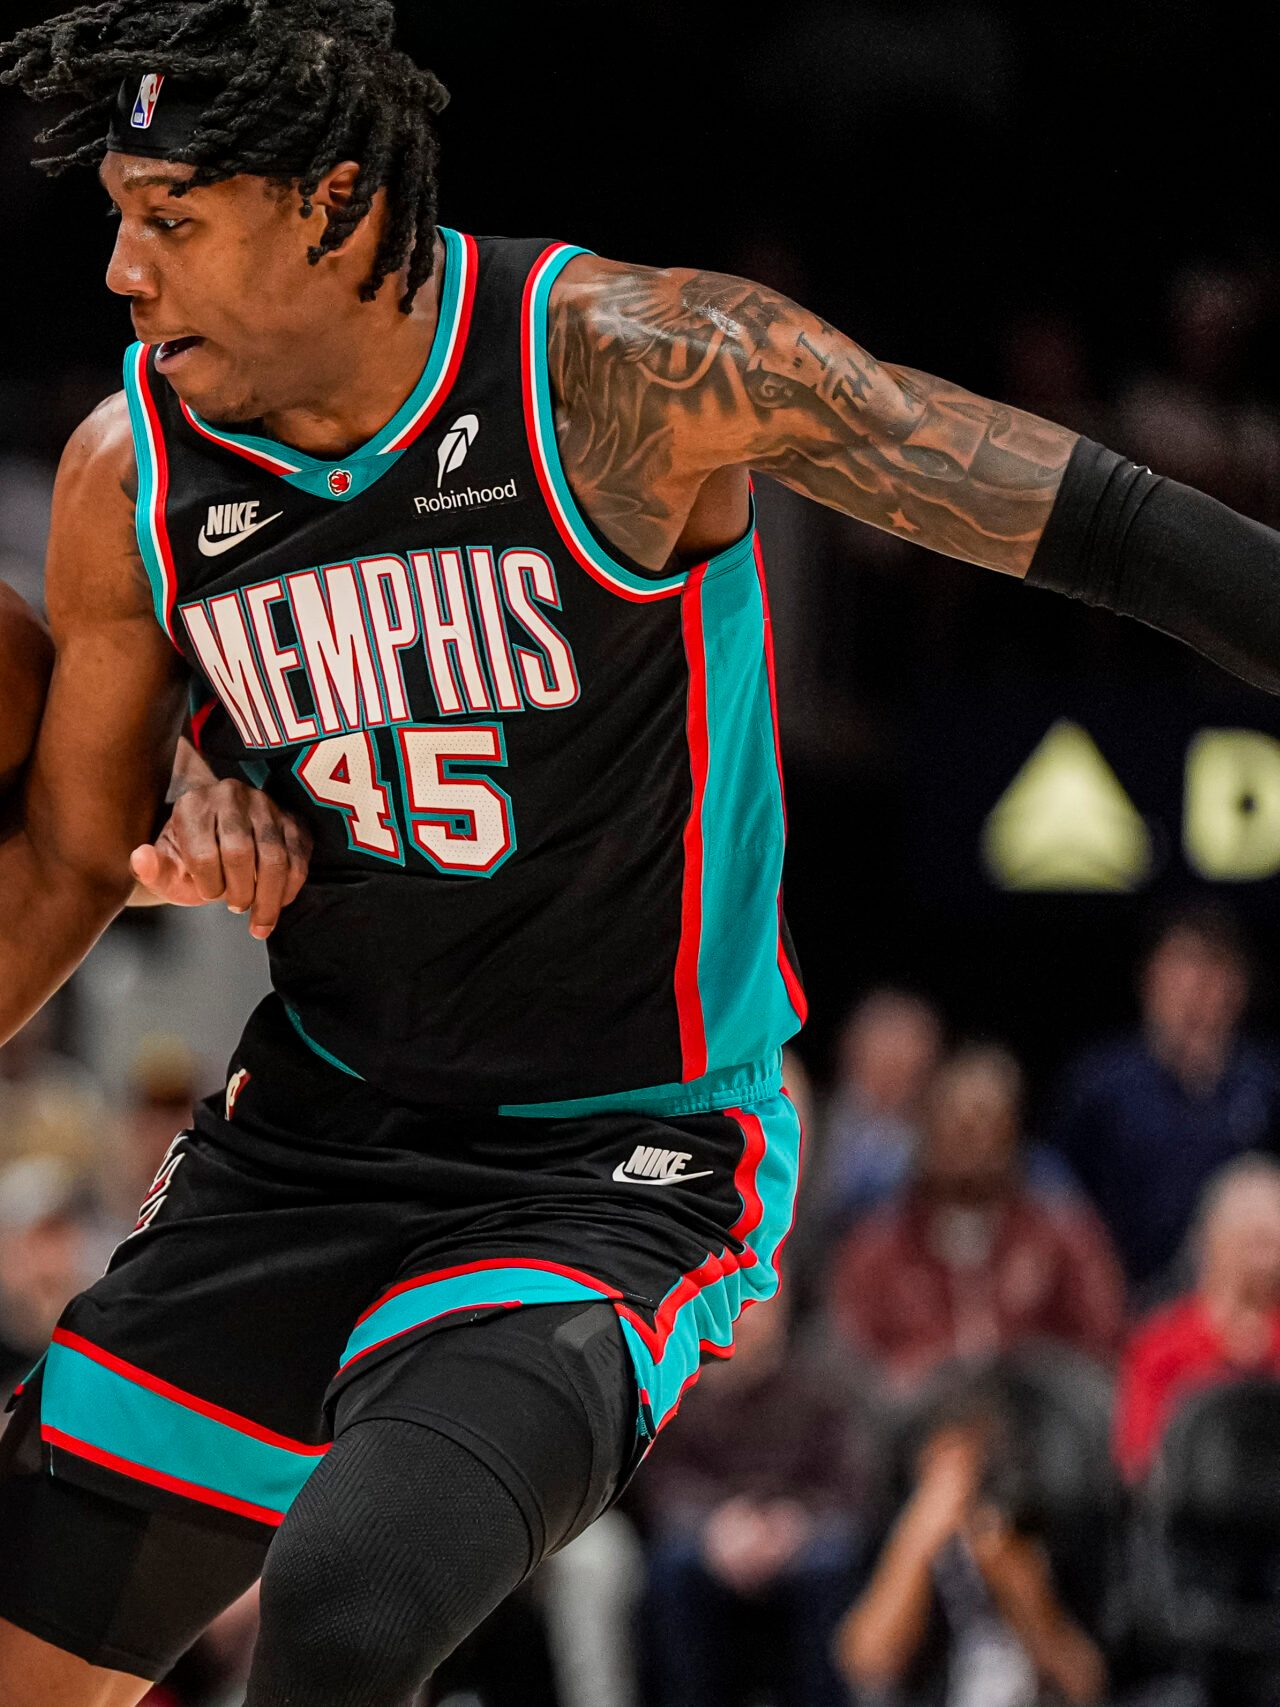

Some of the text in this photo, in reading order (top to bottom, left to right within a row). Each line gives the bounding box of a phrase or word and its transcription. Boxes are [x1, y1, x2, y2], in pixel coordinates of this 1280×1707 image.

[414, 479, 518, 514] Robinhood
[206, 500, 260, 536] NIKE
[177, 545, 582, 749] MEMPHIS
[291, 721, 518, 879] 45
[623, 1145, 693, 1179] NIKE
